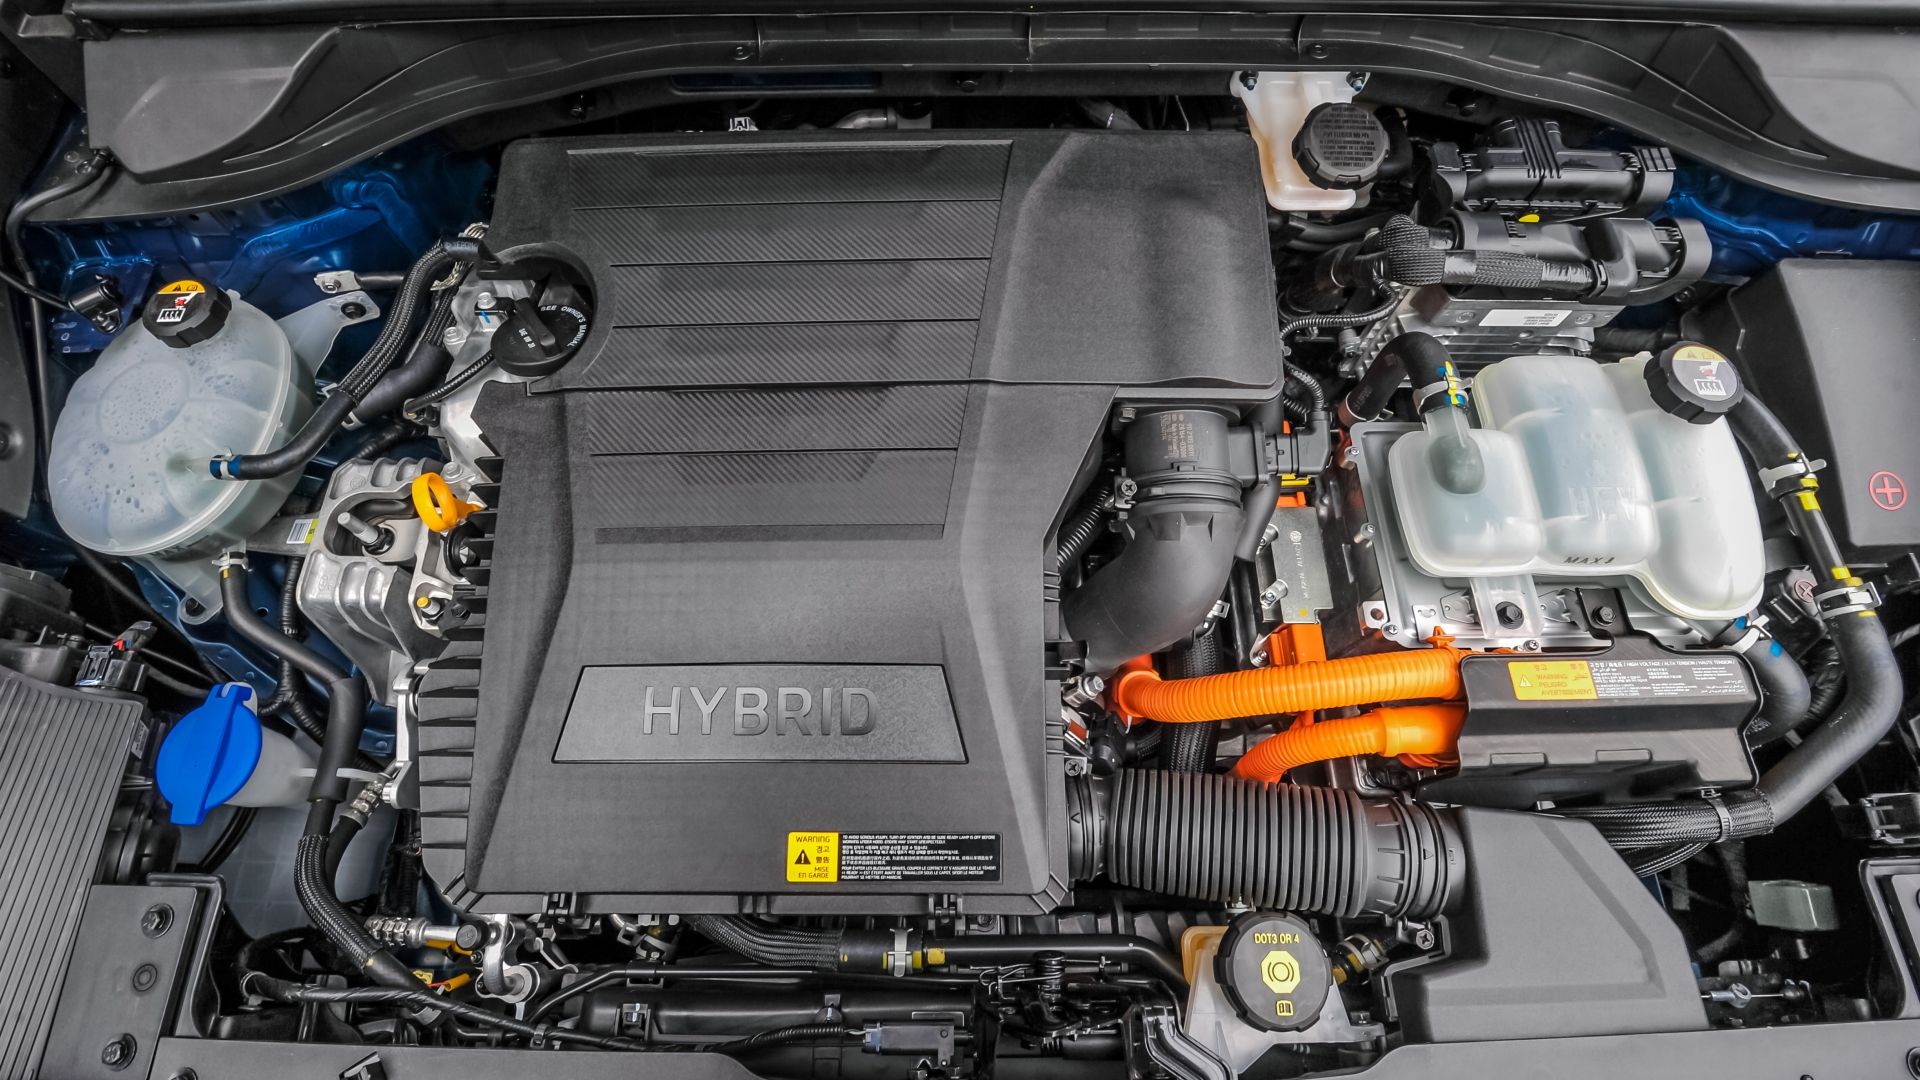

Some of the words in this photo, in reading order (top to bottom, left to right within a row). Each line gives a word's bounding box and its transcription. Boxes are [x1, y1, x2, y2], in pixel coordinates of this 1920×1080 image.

[561, 305, 587, 323] OWNER'S
[566, 324, 587, 347] MANUAL
[1562, 555, 1605, 566] MAX
[642, 686, 878, 736] HYBRID
[1254, 933, 1278, 944] DOT3
[1280, 934, 1292, 944] OR
[1294, 933, 1300, 944] 4
